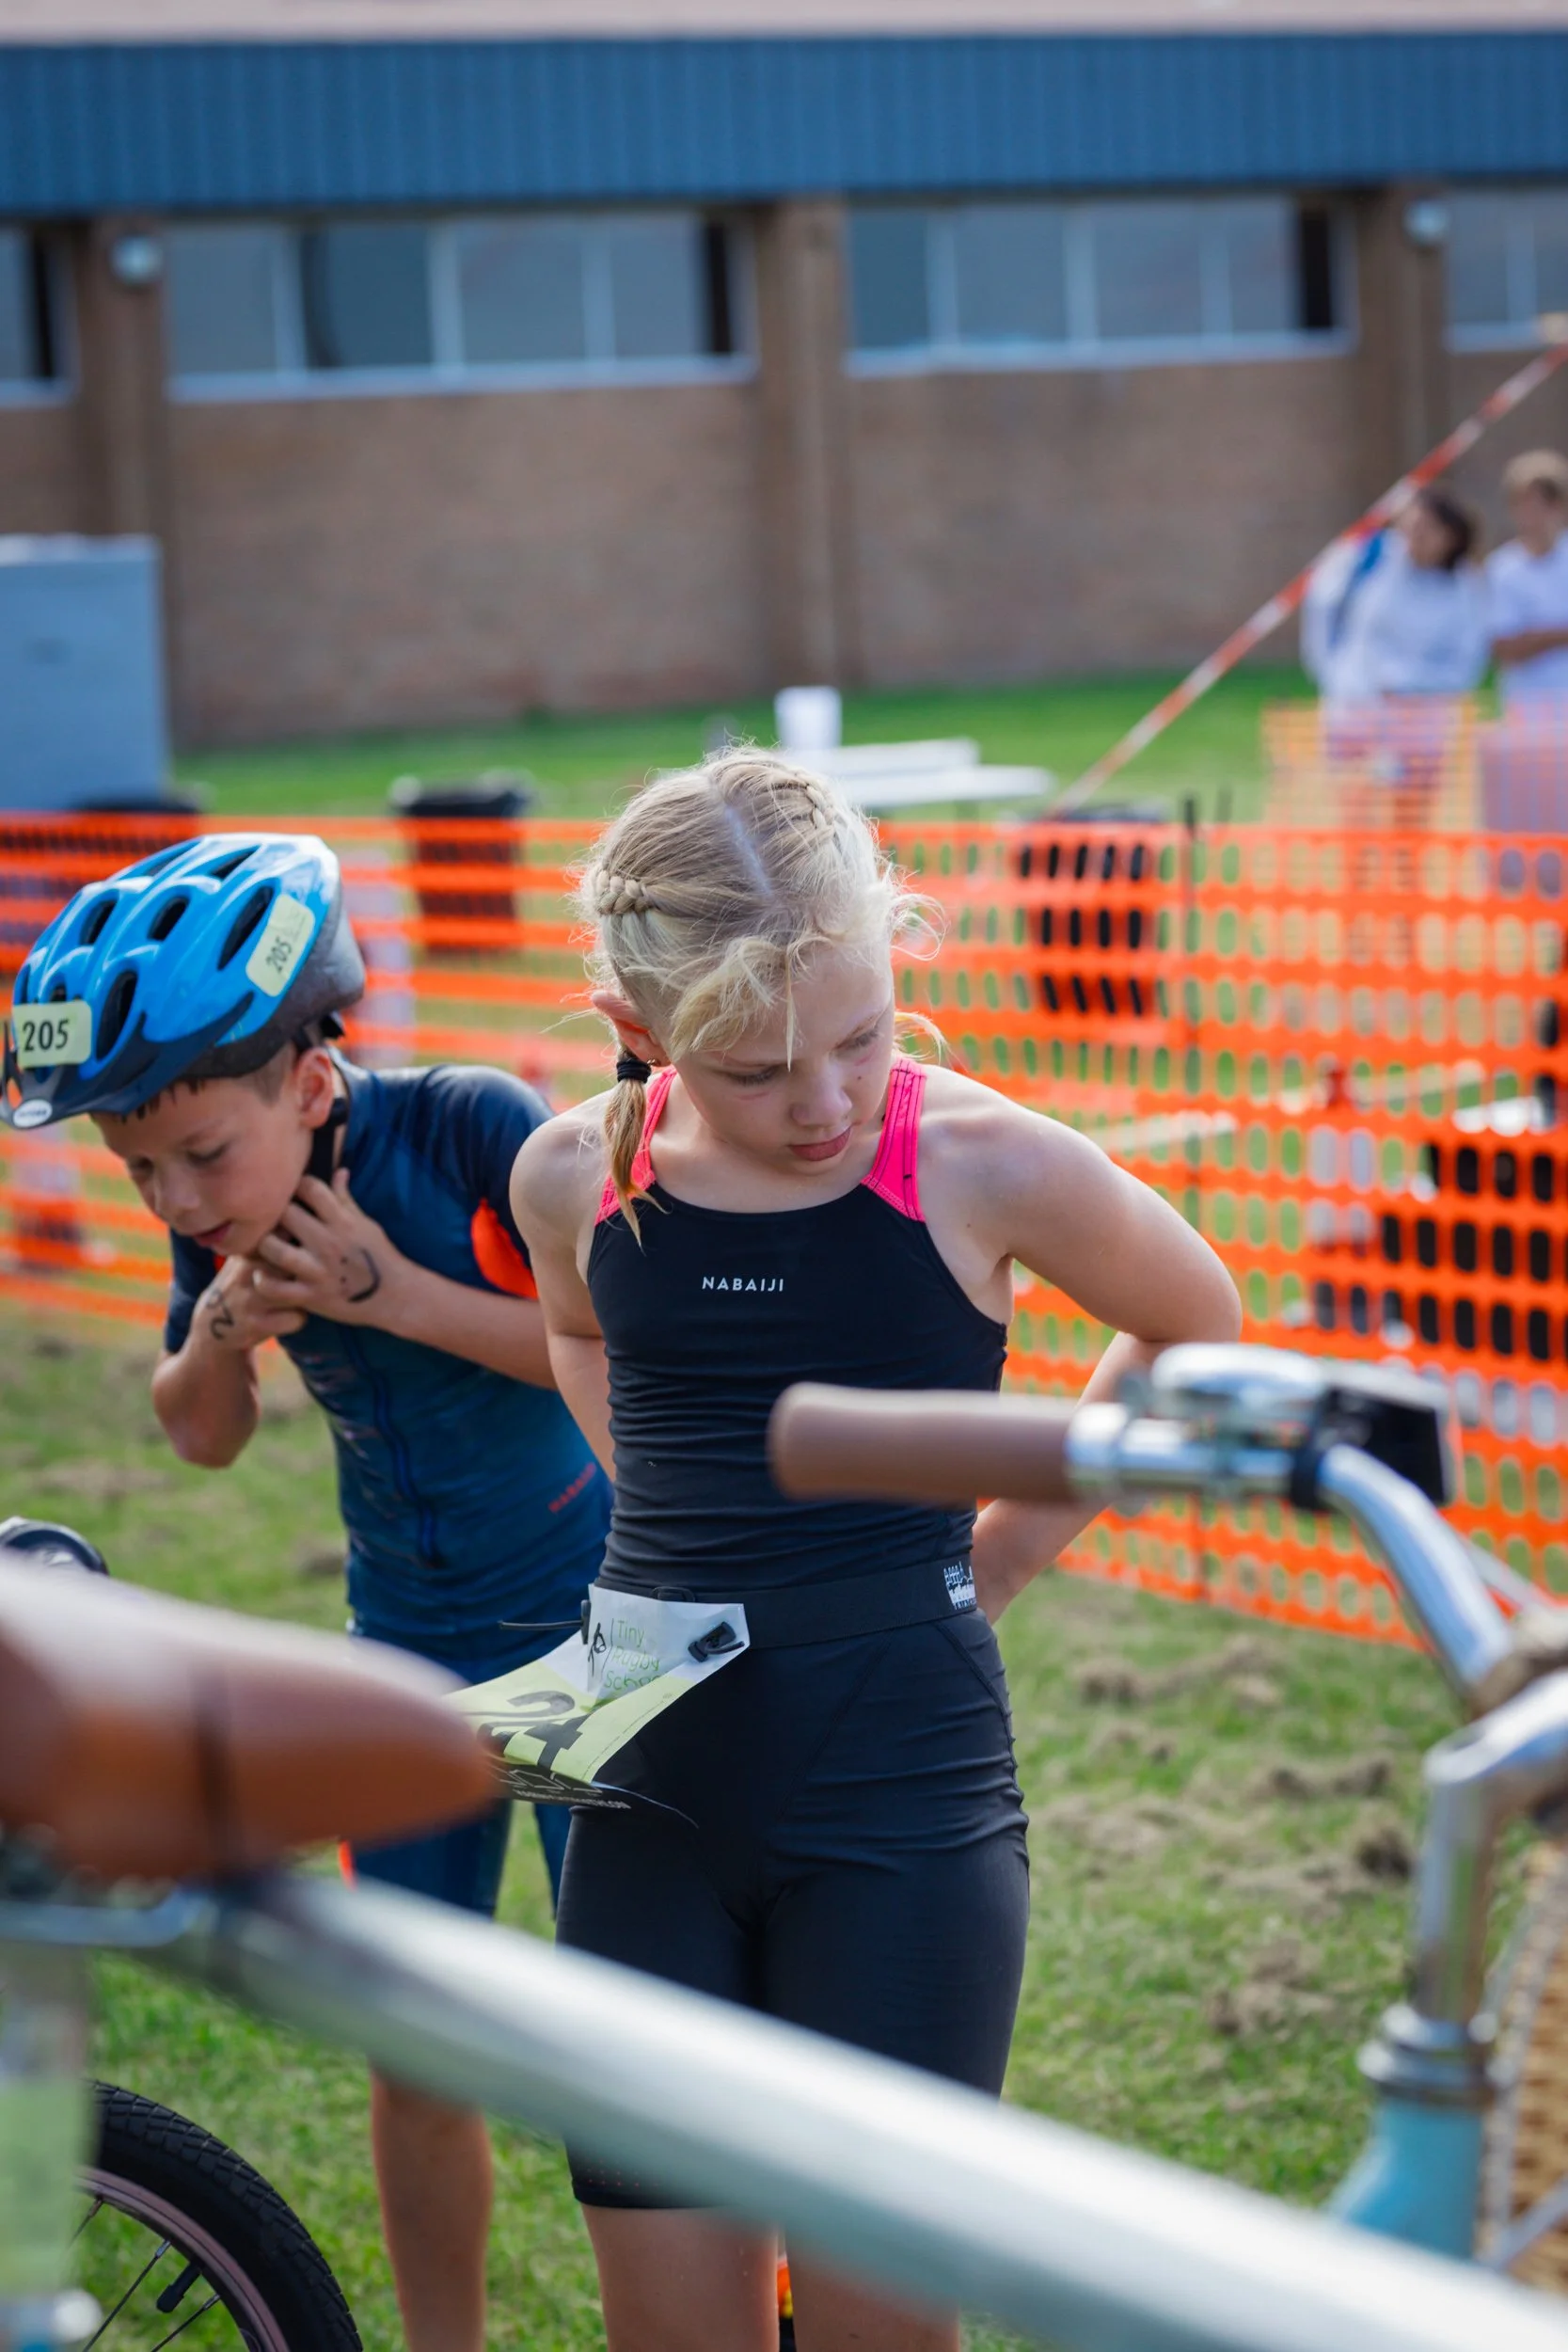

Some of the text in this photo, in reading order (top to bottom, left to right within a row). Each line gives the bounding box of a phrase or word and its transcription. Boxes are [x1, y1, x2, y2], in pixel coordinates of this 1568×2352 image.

[265, 934, 293, 974] 205
[22, 1019, 70, 1053] 205
[702, 1276, 784, 1293] NABAIJI
[616, 1619, 645, 1647] Tiny
[611, 1645, 660, 1673] Rugby
[603, 1670, 662, 1691] Scho
